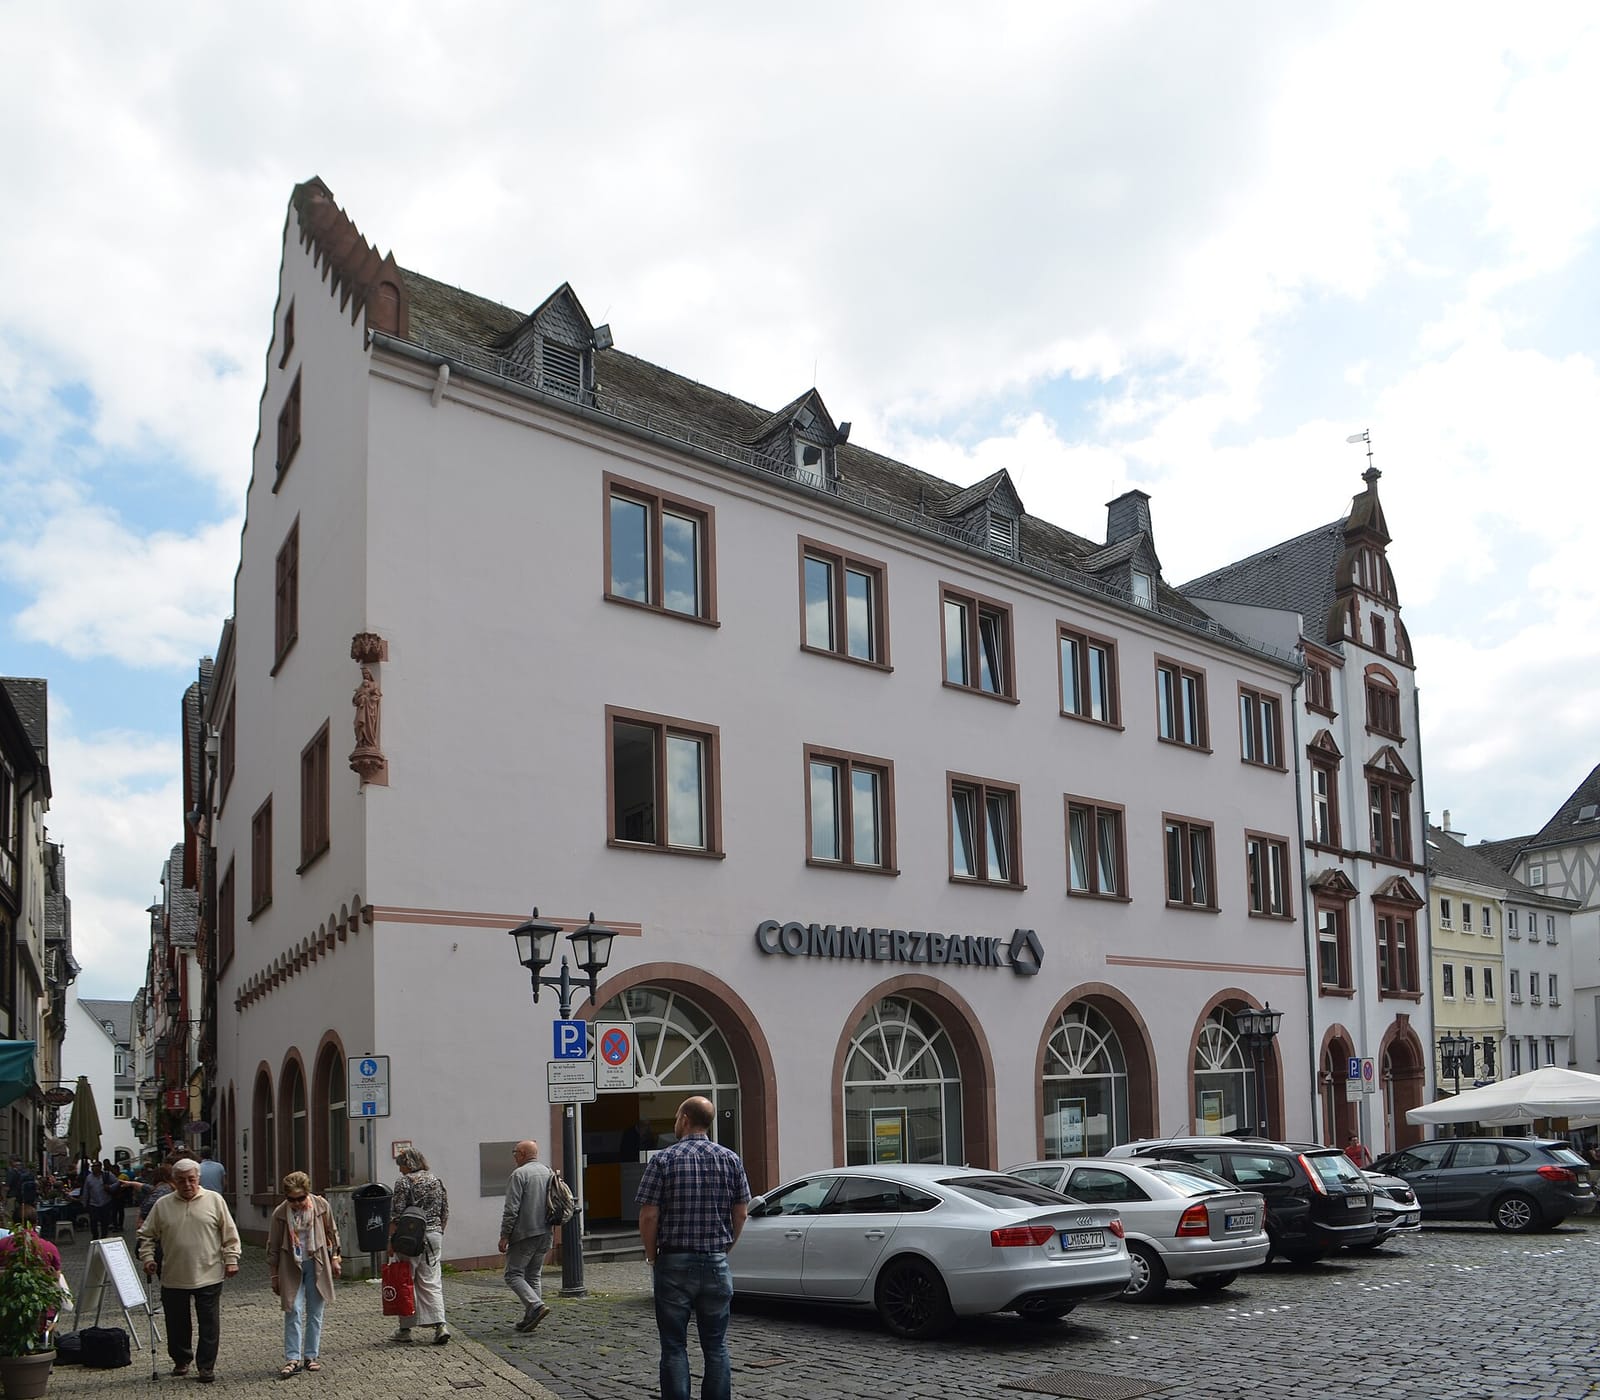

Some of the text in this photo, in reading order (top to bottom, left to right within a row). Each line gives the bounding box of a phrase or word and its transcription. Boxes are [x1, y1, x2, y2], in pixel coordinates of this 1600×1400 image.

[756, 919, 1002, 967] COMMERZBANK
[560, 1024, 579, 1055] P
[1351, 1060, 1358, 1076] P
